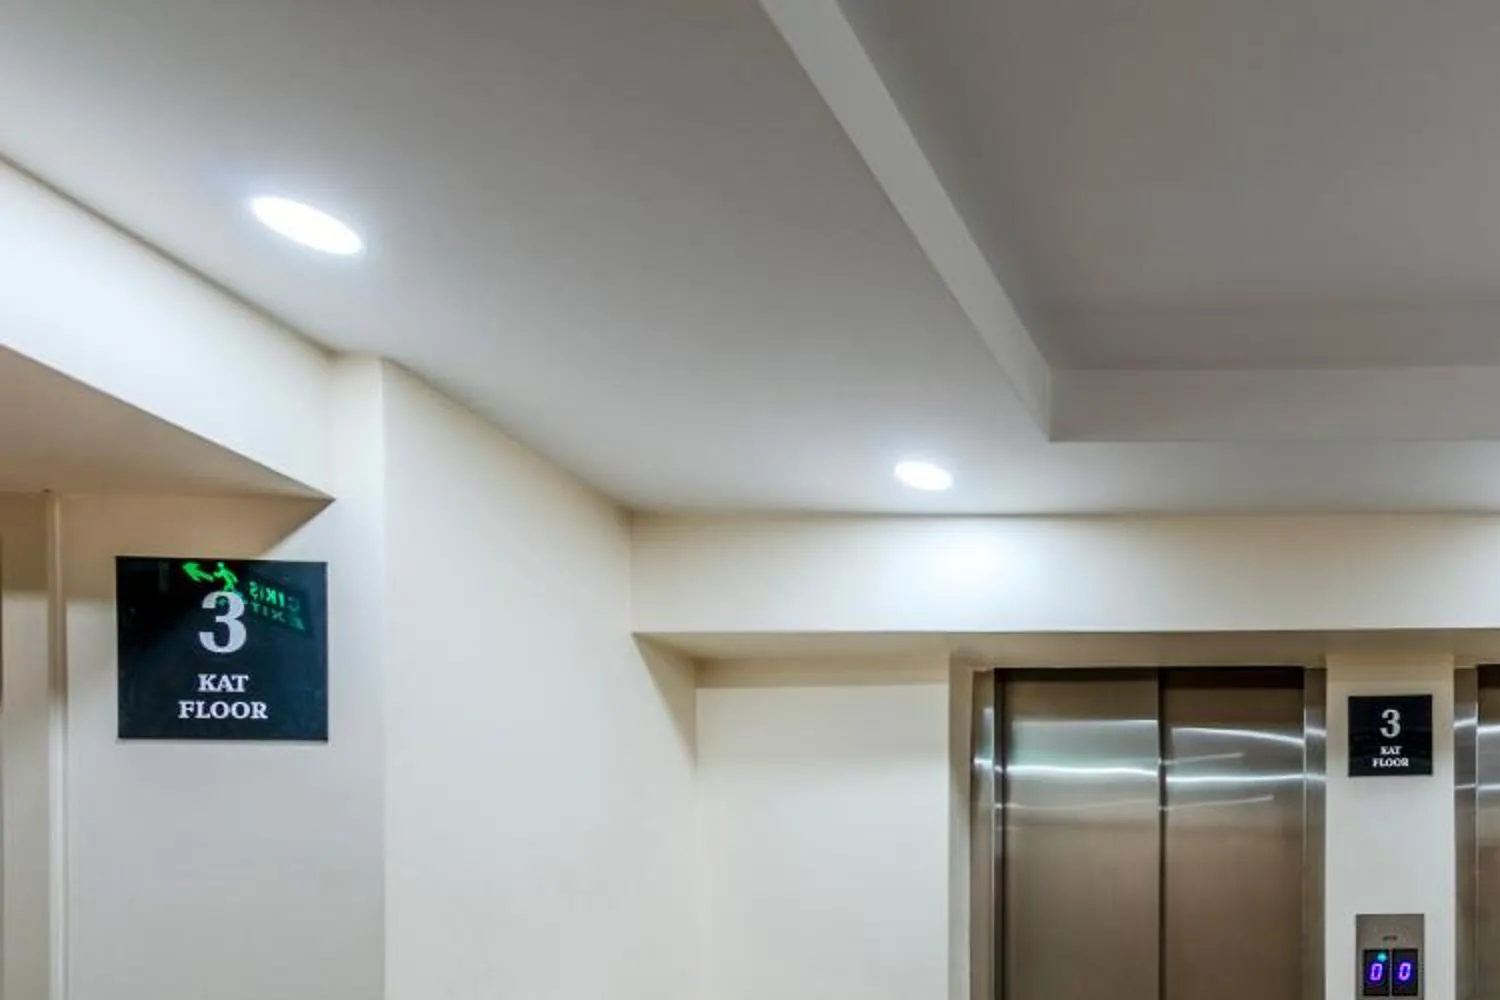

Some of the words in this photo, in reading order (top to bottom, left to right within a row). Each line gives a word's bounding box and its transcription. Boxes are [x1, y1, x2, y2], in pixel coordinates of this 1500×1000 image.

[199, 591, 247, 653] 3
[198, 673, 249, 692] KAT
[178, 700, 268, 719] FLOOR
[1380, 708, 1401, 738] 3
[1380, 745, 1402, 755] KAT
[1372, 757, 1409, 767] FLOOR
[1370, 963, 1383, 981] 0
[1398, 962, 1412, 981] 0
